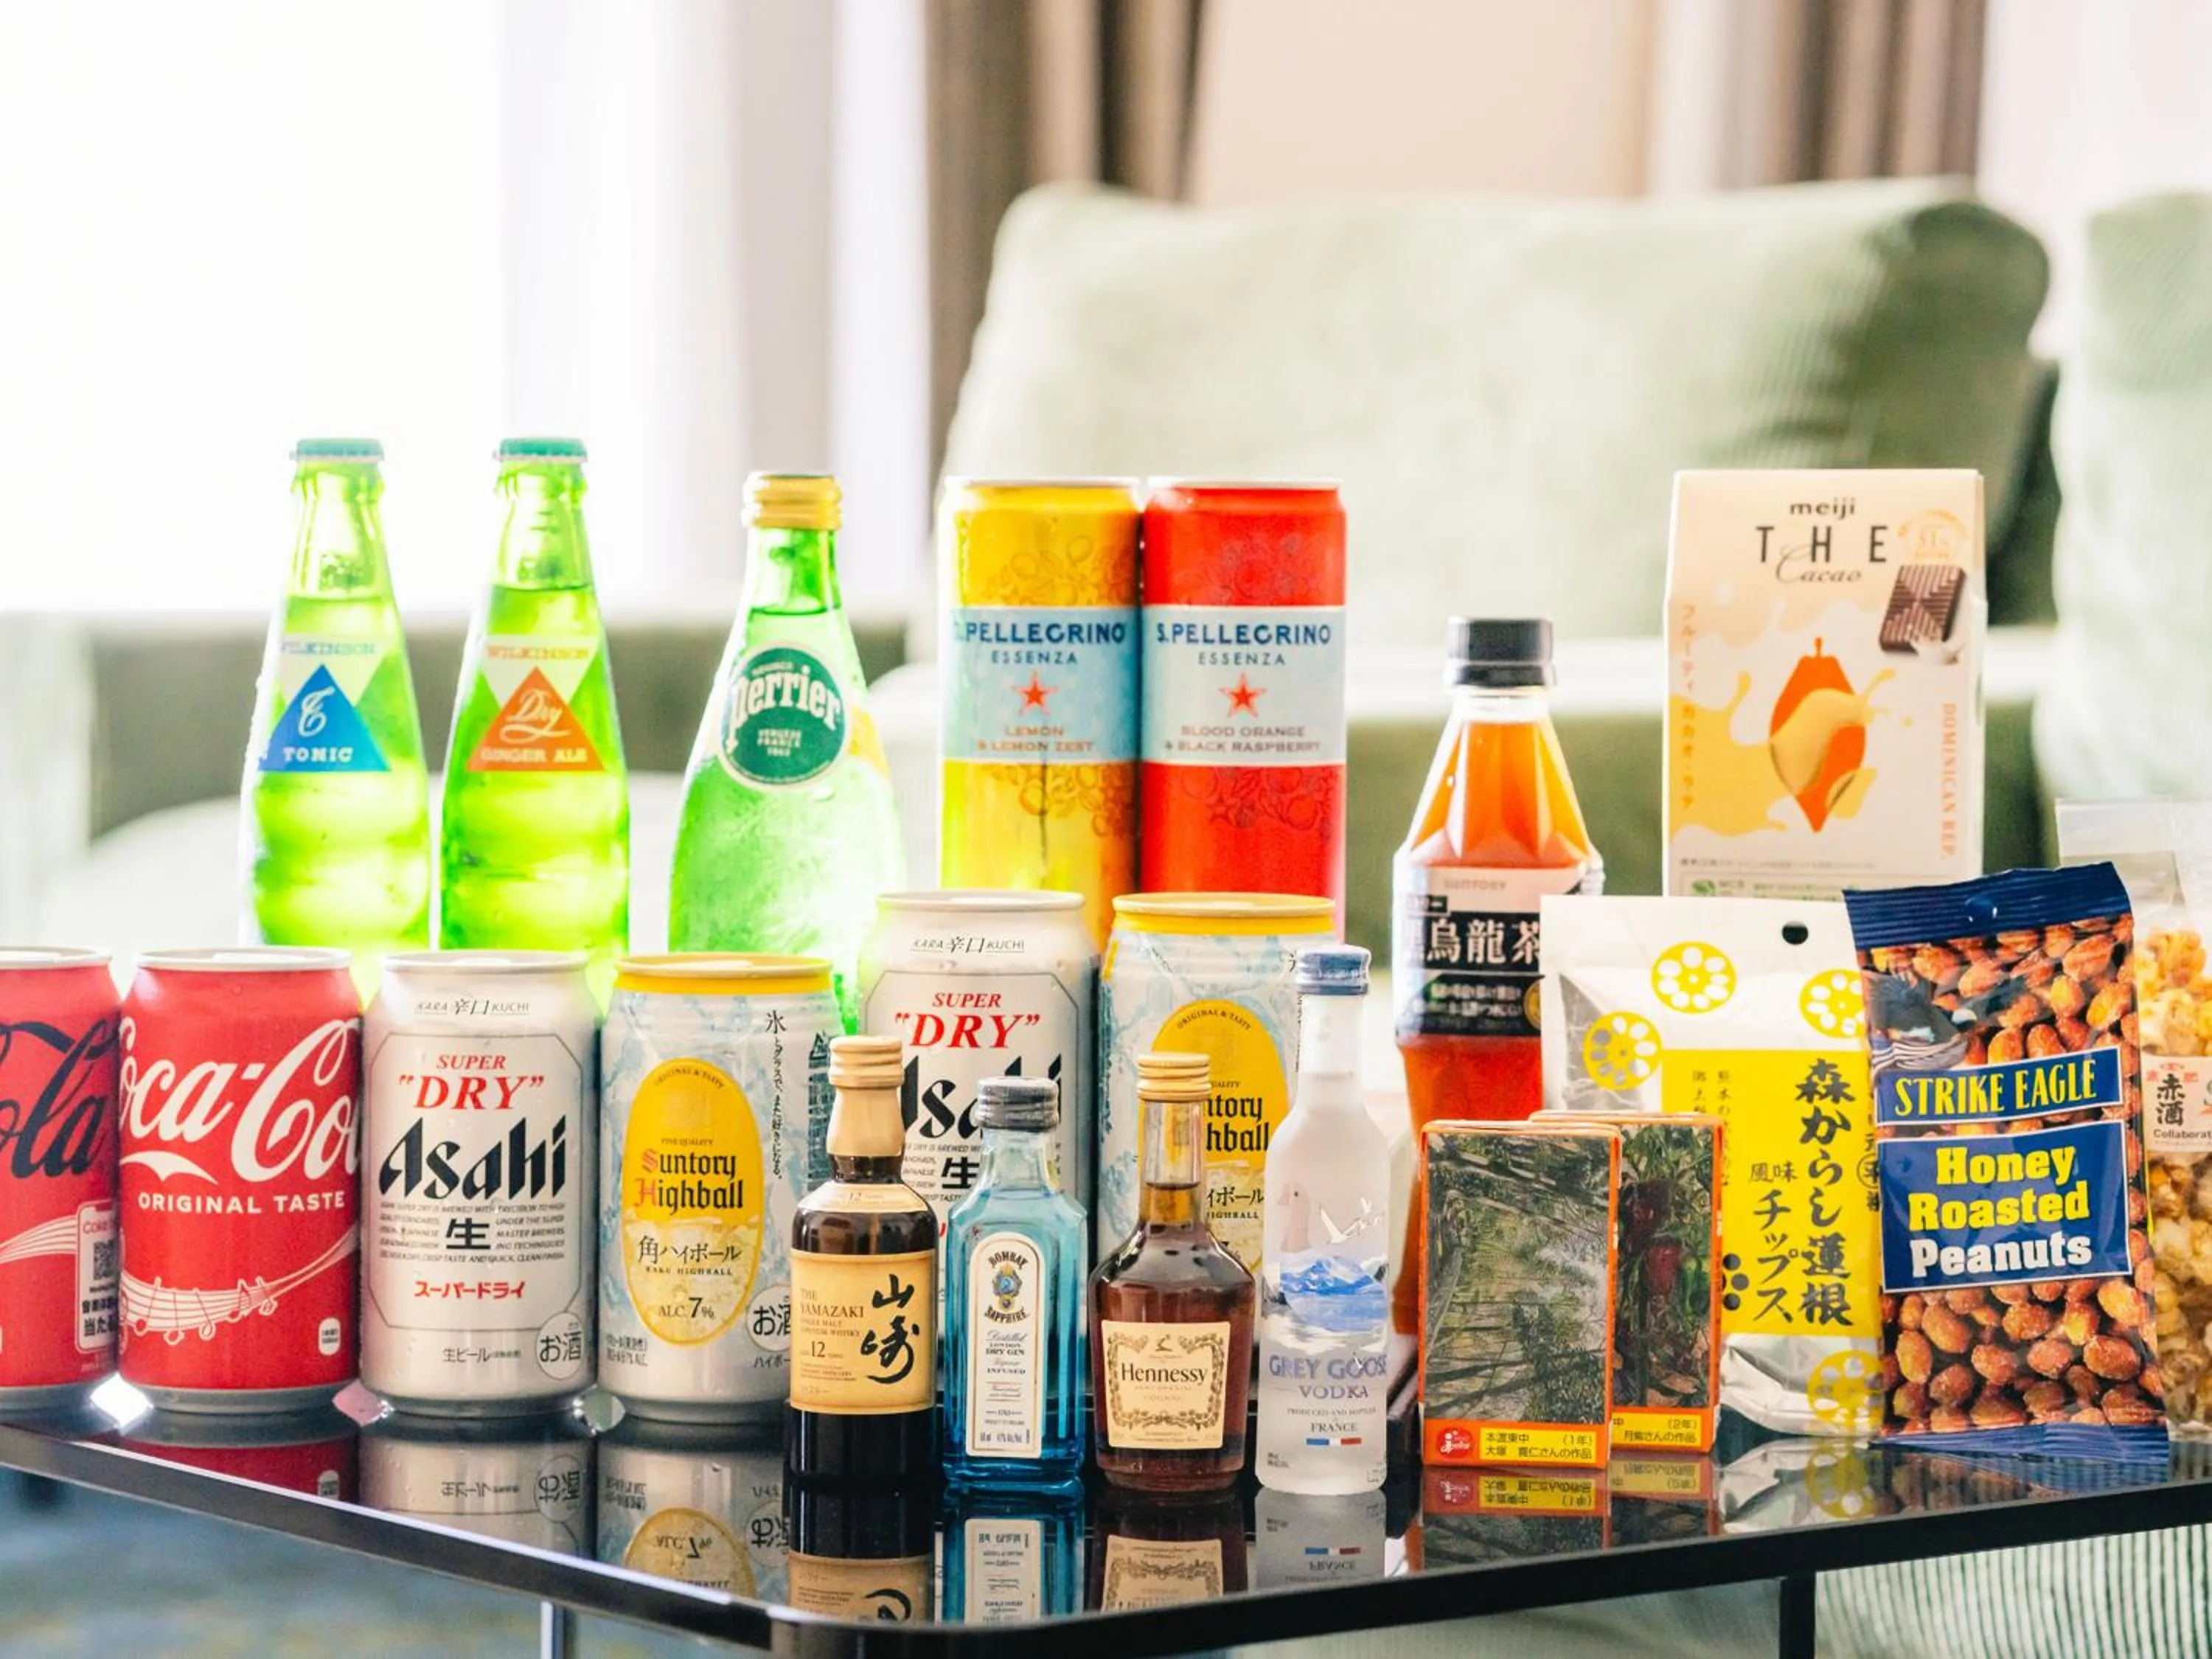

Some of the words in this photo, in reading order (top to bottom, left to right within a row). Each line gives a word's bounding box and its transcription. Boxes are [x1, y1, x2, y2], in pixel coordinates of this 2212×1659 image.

[1790, 497, 1855, 518] meiji
[1775, 545, 1862, 583] Cacao
[956, 623, 1125, 644] .PELLEGRINO
[1157, 624, 1332, 645] S.PELLEGRINO
[487, 645, 588, 659] WILKINSON
[991, 652, 1077, 664] ESSENZA
[1198, 652, 1285, 665] ESSENZA
[1005, 726, 1063, 737] LEMON
[1182, 726, 1234, 737] BLOOD
[1240, 726, 1306, 737] ORANGE
[282, 747, 354, 763] TONIC
[480, 747, 546, 763] GINGER
[554, 748, 589, 763] ALE
[991, 741, 1048, 752] LEMON
[1054, 741, 1095, 753] ZEST
[1179, 741, 1227, 752] BLACK
[1232, 741, 1321, 753] RASPBERRY
[986, 939, 1025, 950] KUCHI
[491, 1002, 530, 1013] KUCHI
[932, 992, 1001, 1009] SUPER
[436, 1054, 507, 1069] SUPER
[1894, 1073, 2005, 1116] STRIKE
[2014, 1059, 2097, 1110] EAGLE
[1206, 1121, 1270, 1152] hball
[378, 1115, 567, 1201] Asahi
[641, 1148, 737, 1180] Suntory
[1935, 1144, 2076, 1187] Honey
[941, 1156, 980, 1189] 生
[1750, 1158, 1798, 1183] 風味
[139, 1192, 261, 1214] ORIGINAL
[274, 1192, 345, 1212] TASTE
[633, 1178, 745, 1216] Highball
[1206, 1186, 1265, 1208] イボール
[1908, 1180, 2090, 1231] Roasted
[495, 1217, 524, 1225] UNDER
[445, 1217, 491, 1250] 生
[496, 1228, 529, 1238] MASTER
[639, 1234, 742, 1265] 角ハイボール
[1752, 1189, 1801, 1324] チップス
[1910, 1234, 2092, 1278] Peanuts
[987, 1251, 1029, 1270] BOMBAY
[677, 1267, 732, 1276] HIGHBALL
[413, 1281, 527, 1300] スーパードライ
[800, 1302, 864, 1318] YAMAZAKI
[984, 1305, 1029, 1324] SAPPHIRE
[539, 1330, 582, 1363] お酒
[811, 1340, 826, 1357] 12
[986, 1348, 1005, 1356] DRY
[754, 1354, 790, 1369] ハイボー
[1269, 1355, 1321, 1380] GREY
[1121, 1362, 1208, 1386] Hennessy
[1298, 1384, 1369, 1400] VODKA
[1311, 1422, 1358, 1433] FRANCE
